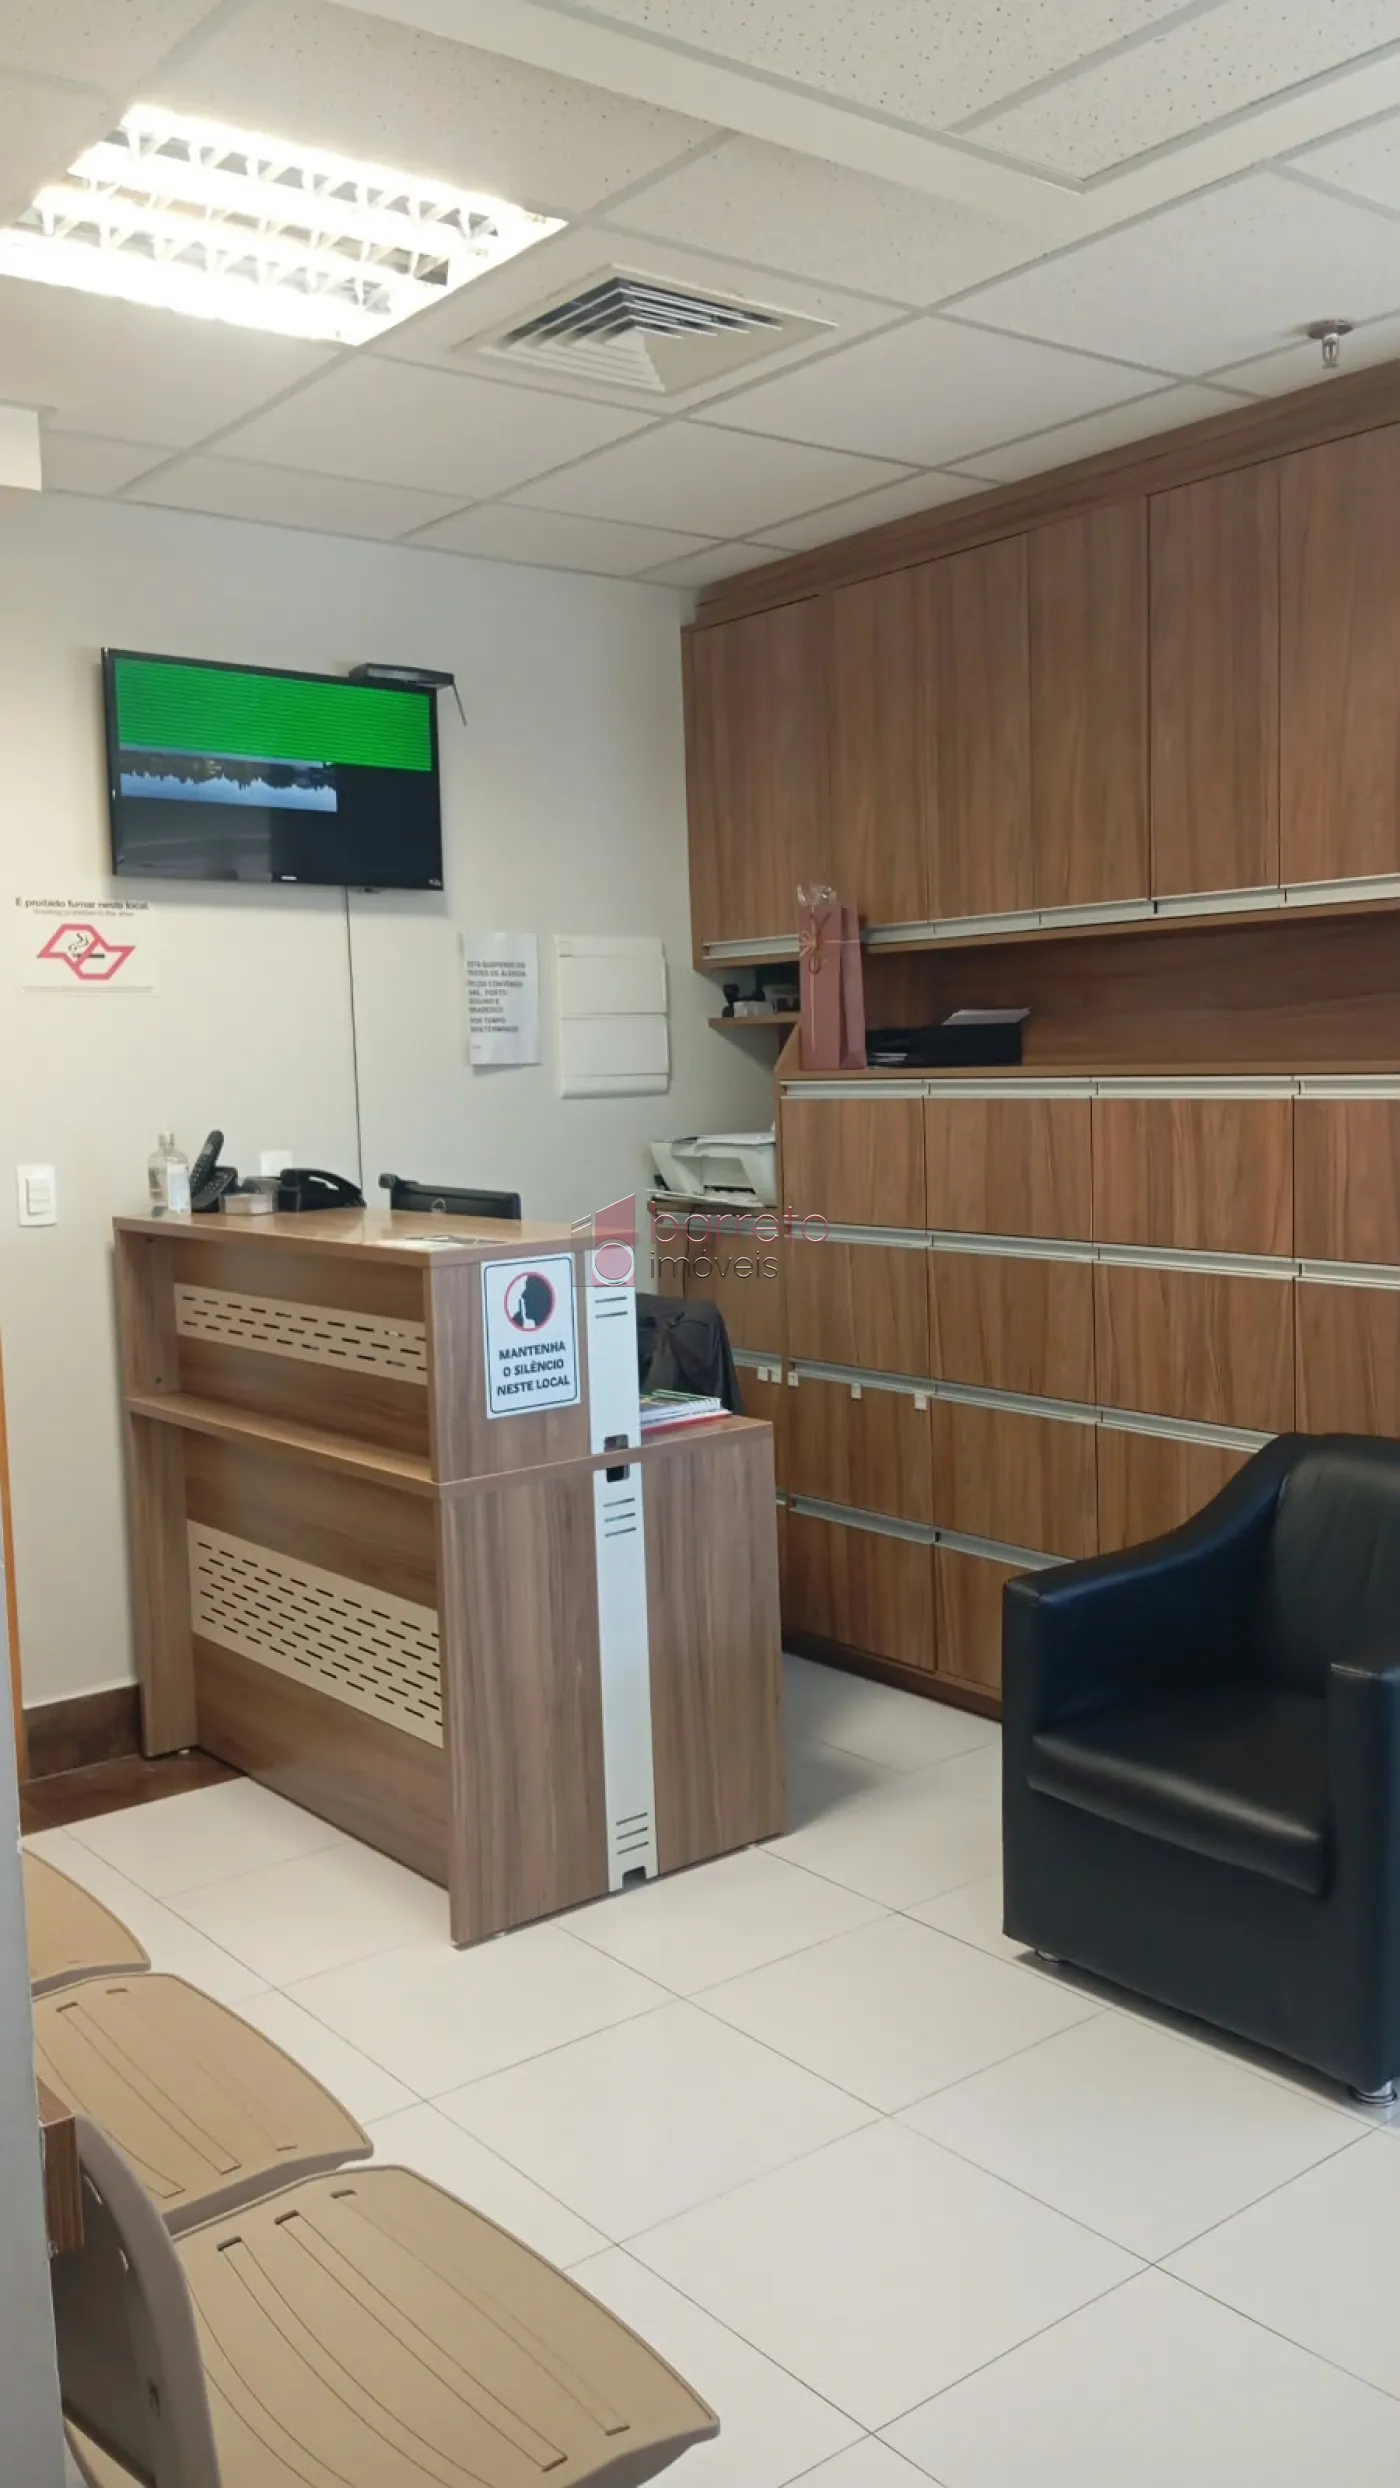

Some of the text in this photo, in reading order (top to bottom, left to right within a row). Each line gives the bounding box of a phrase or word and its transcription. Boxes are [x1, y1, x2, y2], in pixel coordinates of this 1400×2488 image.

[499, 1341, 566, 1360] MANTENHA
[503, 1358, 564, 1377] O SILÊNCIO
[496, 1375, 570, 1397] NESTE LOCAL
